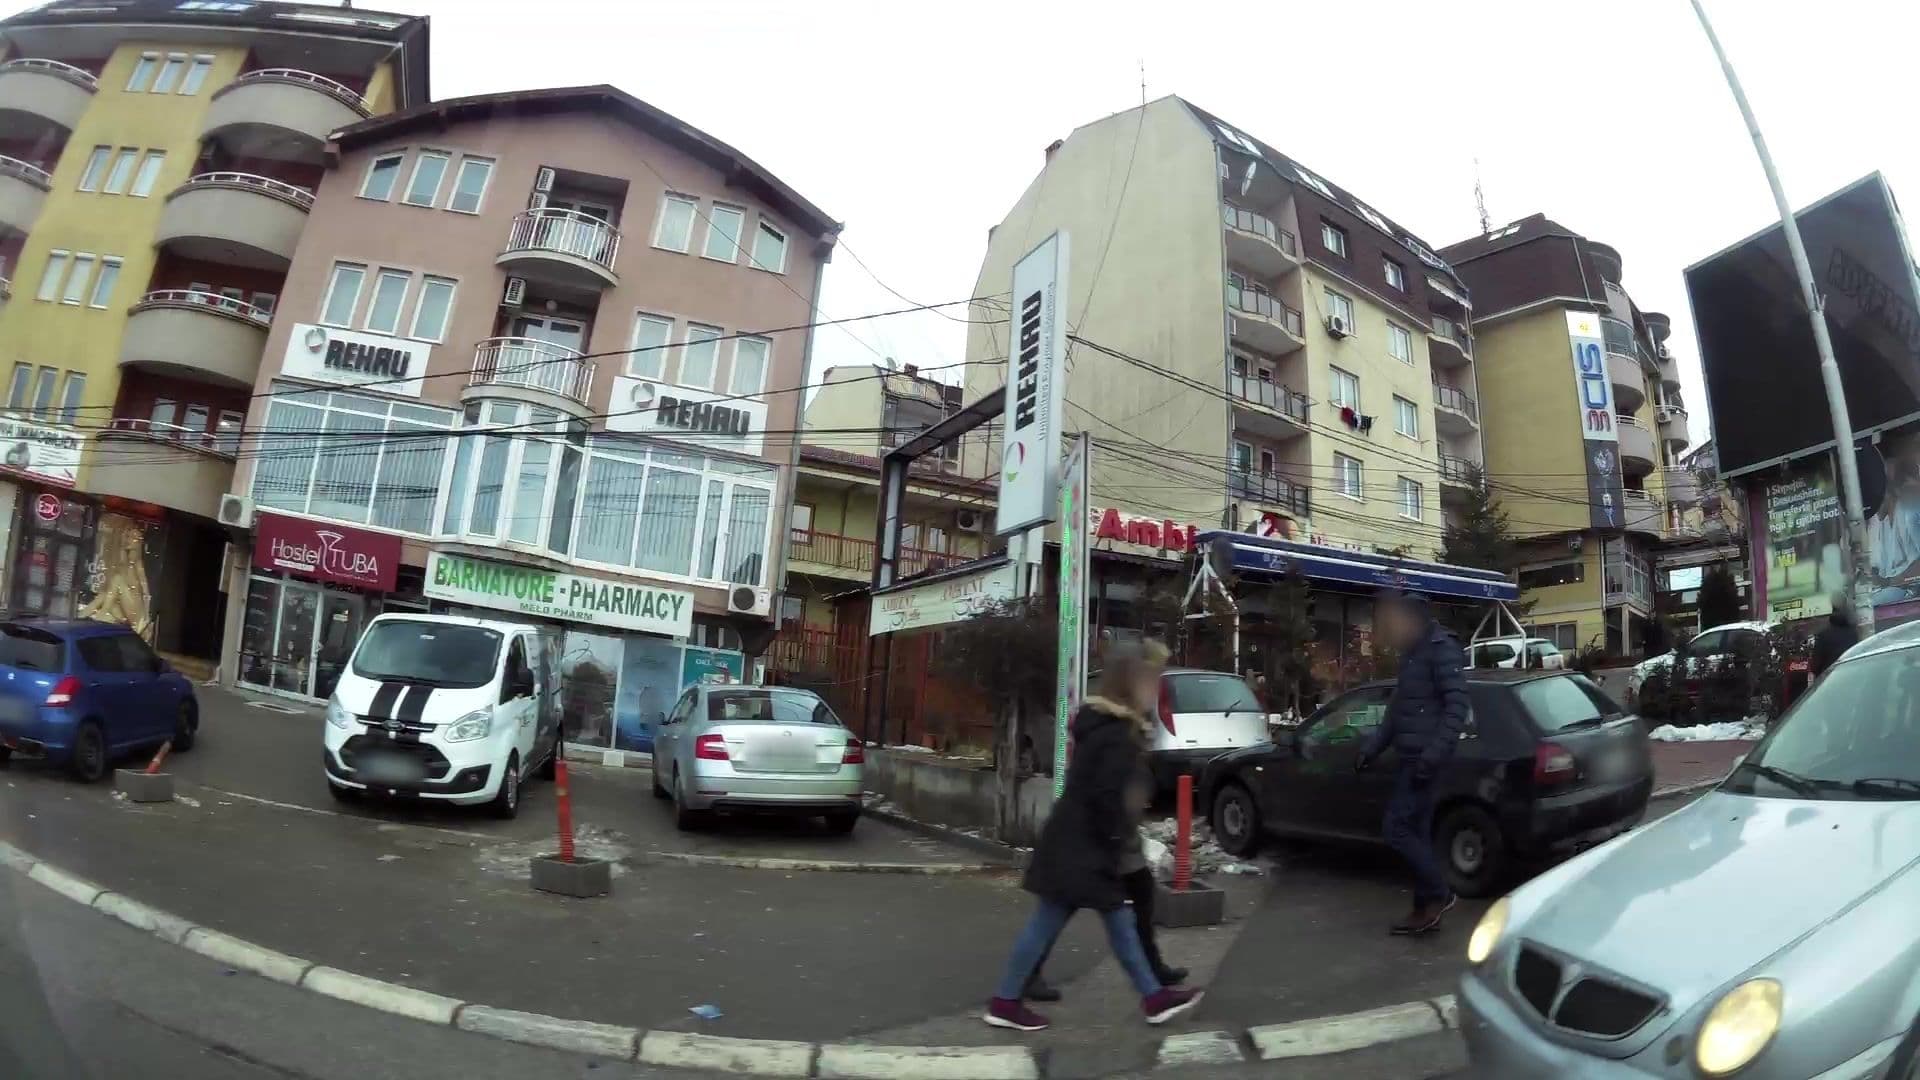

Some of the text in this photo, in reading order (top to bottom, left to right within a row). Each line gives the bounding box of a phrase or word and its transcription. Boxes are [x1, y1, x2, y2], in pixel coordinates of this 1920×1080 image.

[324, 339, 411, 378] REHAU
[1015, 290, 1042, 432] REHAU
[656, 395, 751, 436] REHAU
[270, 538, 322, 565] Hostel
[328, 547, 378, 576] TUBA
[434, 557, 556, 603] BARNATORE
[568, 579, 684, 621] PHARMACY
[553, 606, 593, 620] PHARM
